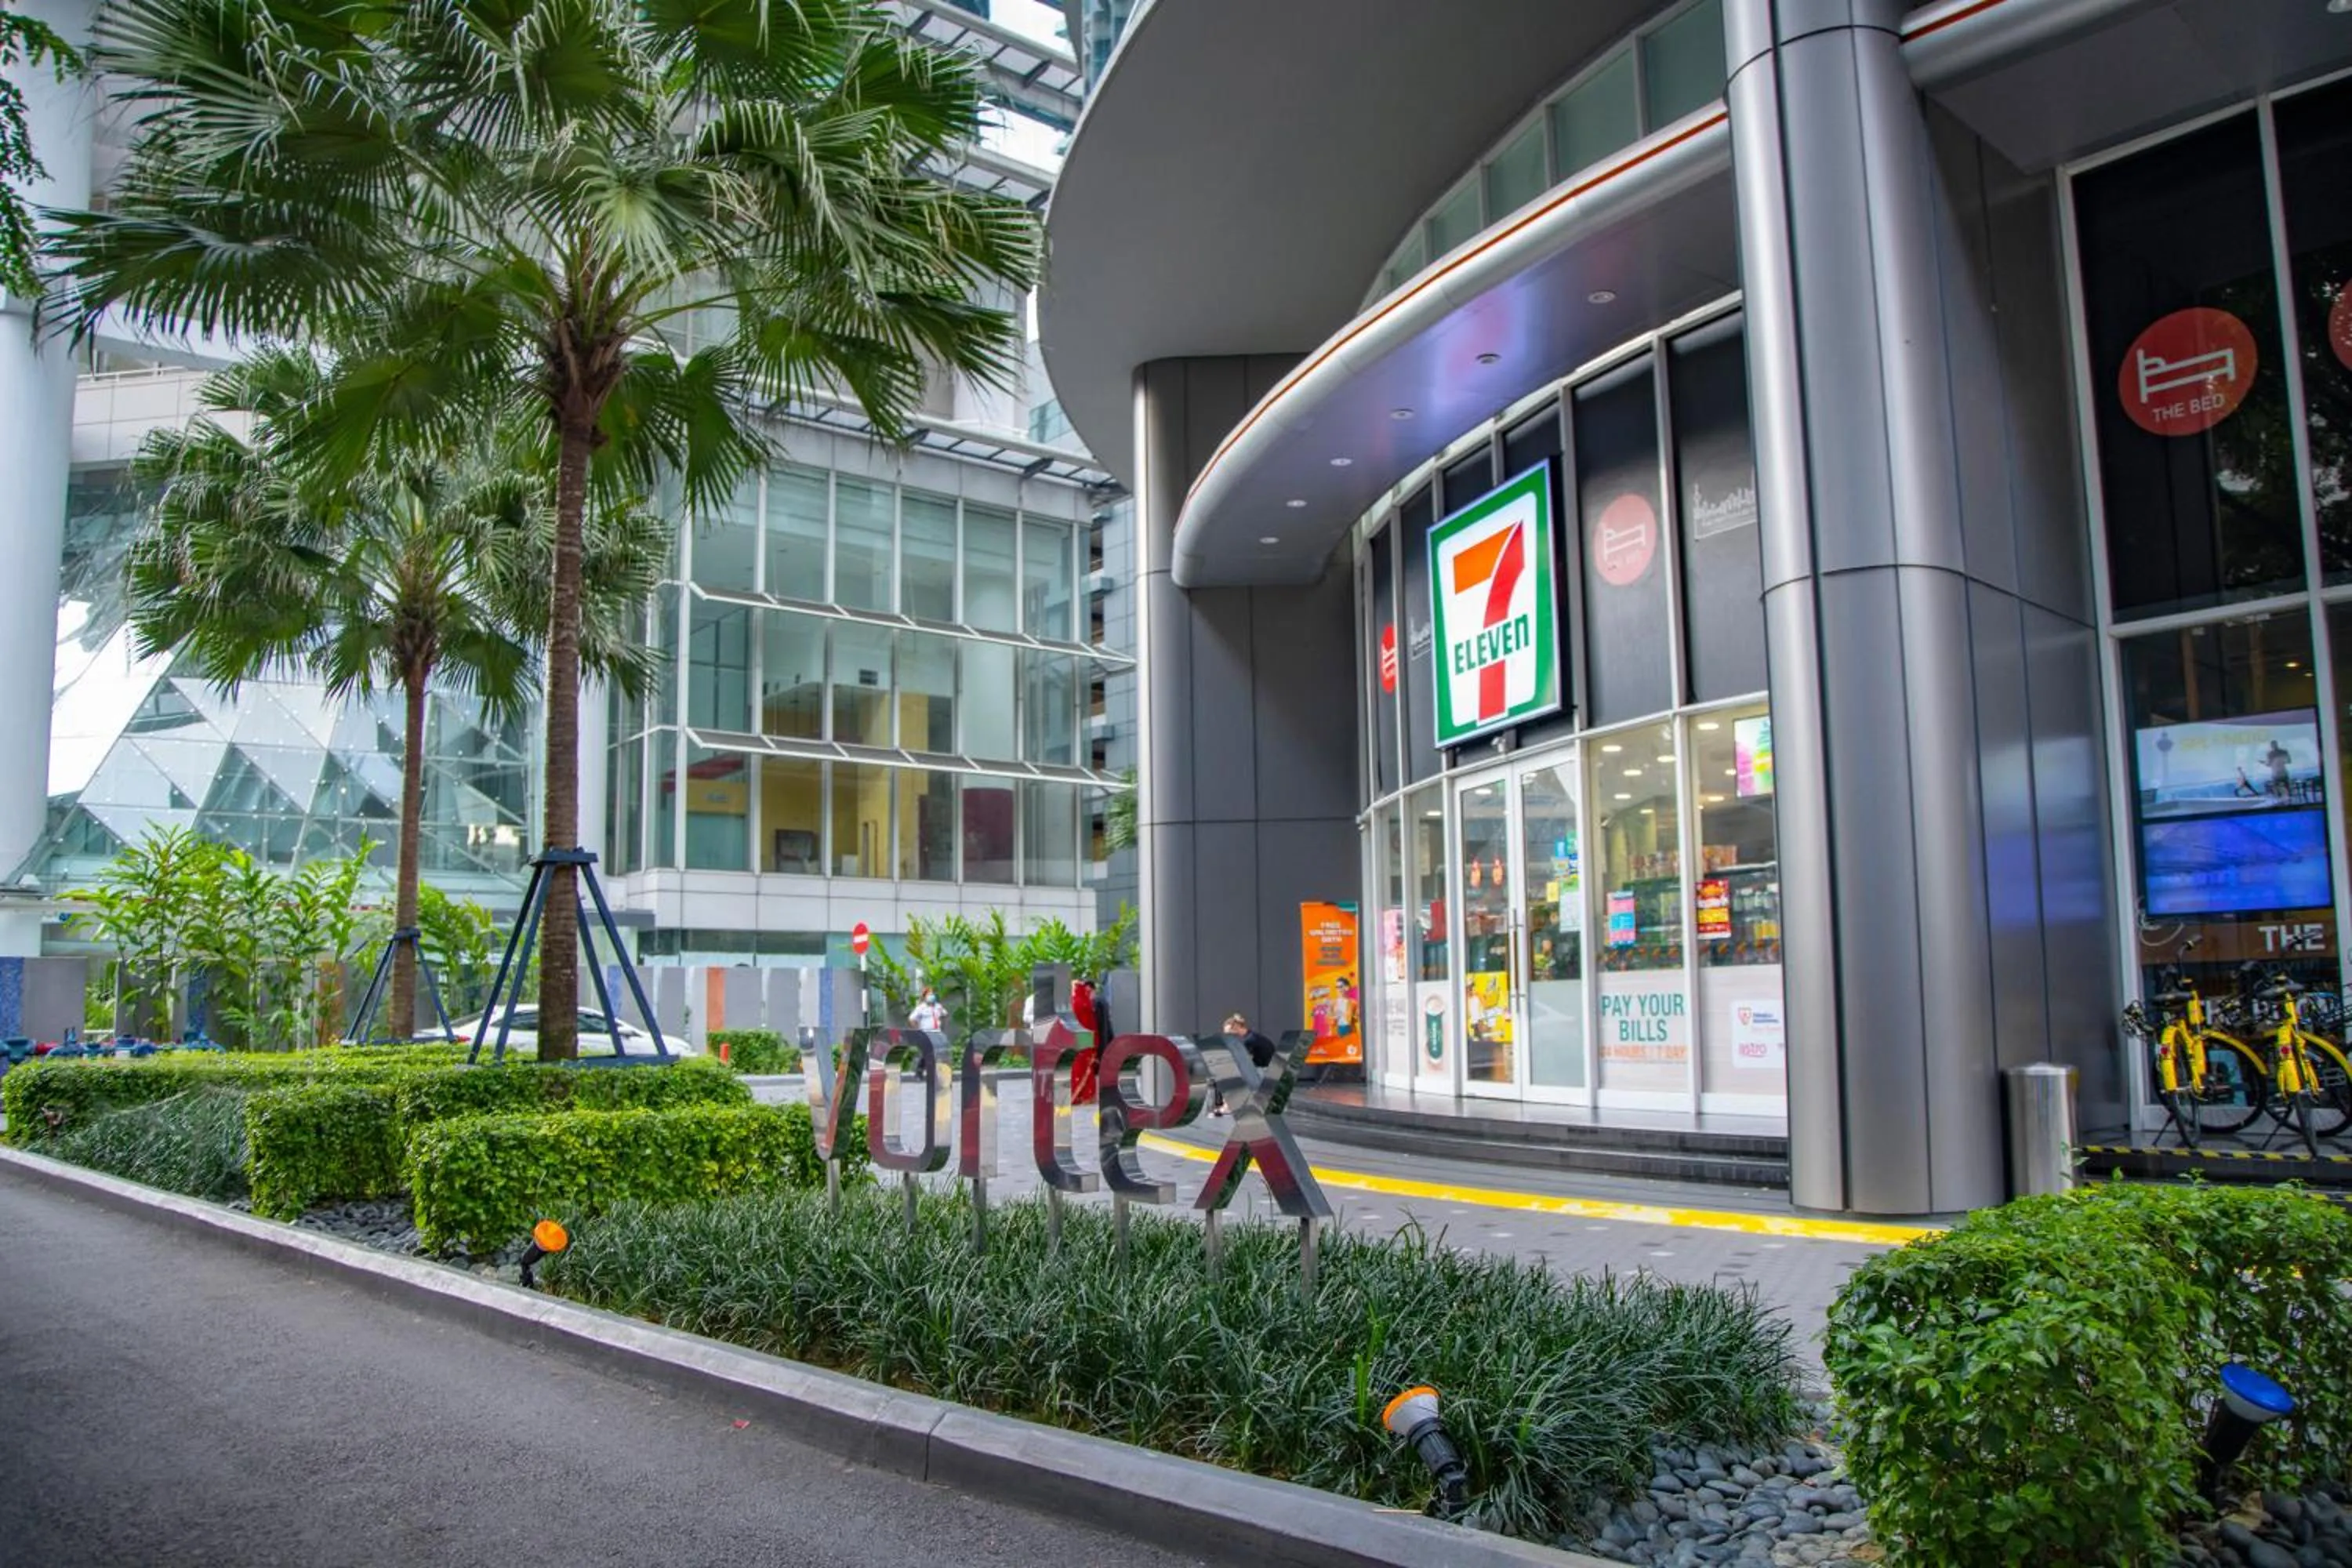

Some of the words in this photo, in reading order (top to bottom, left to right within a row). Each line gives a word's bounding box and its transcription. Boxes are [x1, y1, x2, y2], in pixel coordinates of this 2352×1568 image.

[2151, 402, 2185, 423] THE
[2190, 393, 2225, 415] BED
[2257, 922, 2326, 953] THE
[1601, 994, 1632, 1017] PAY
[1637, 993, 1685, 1017] YOUR
[1619, 1019, 1668, 1042] BILLS
